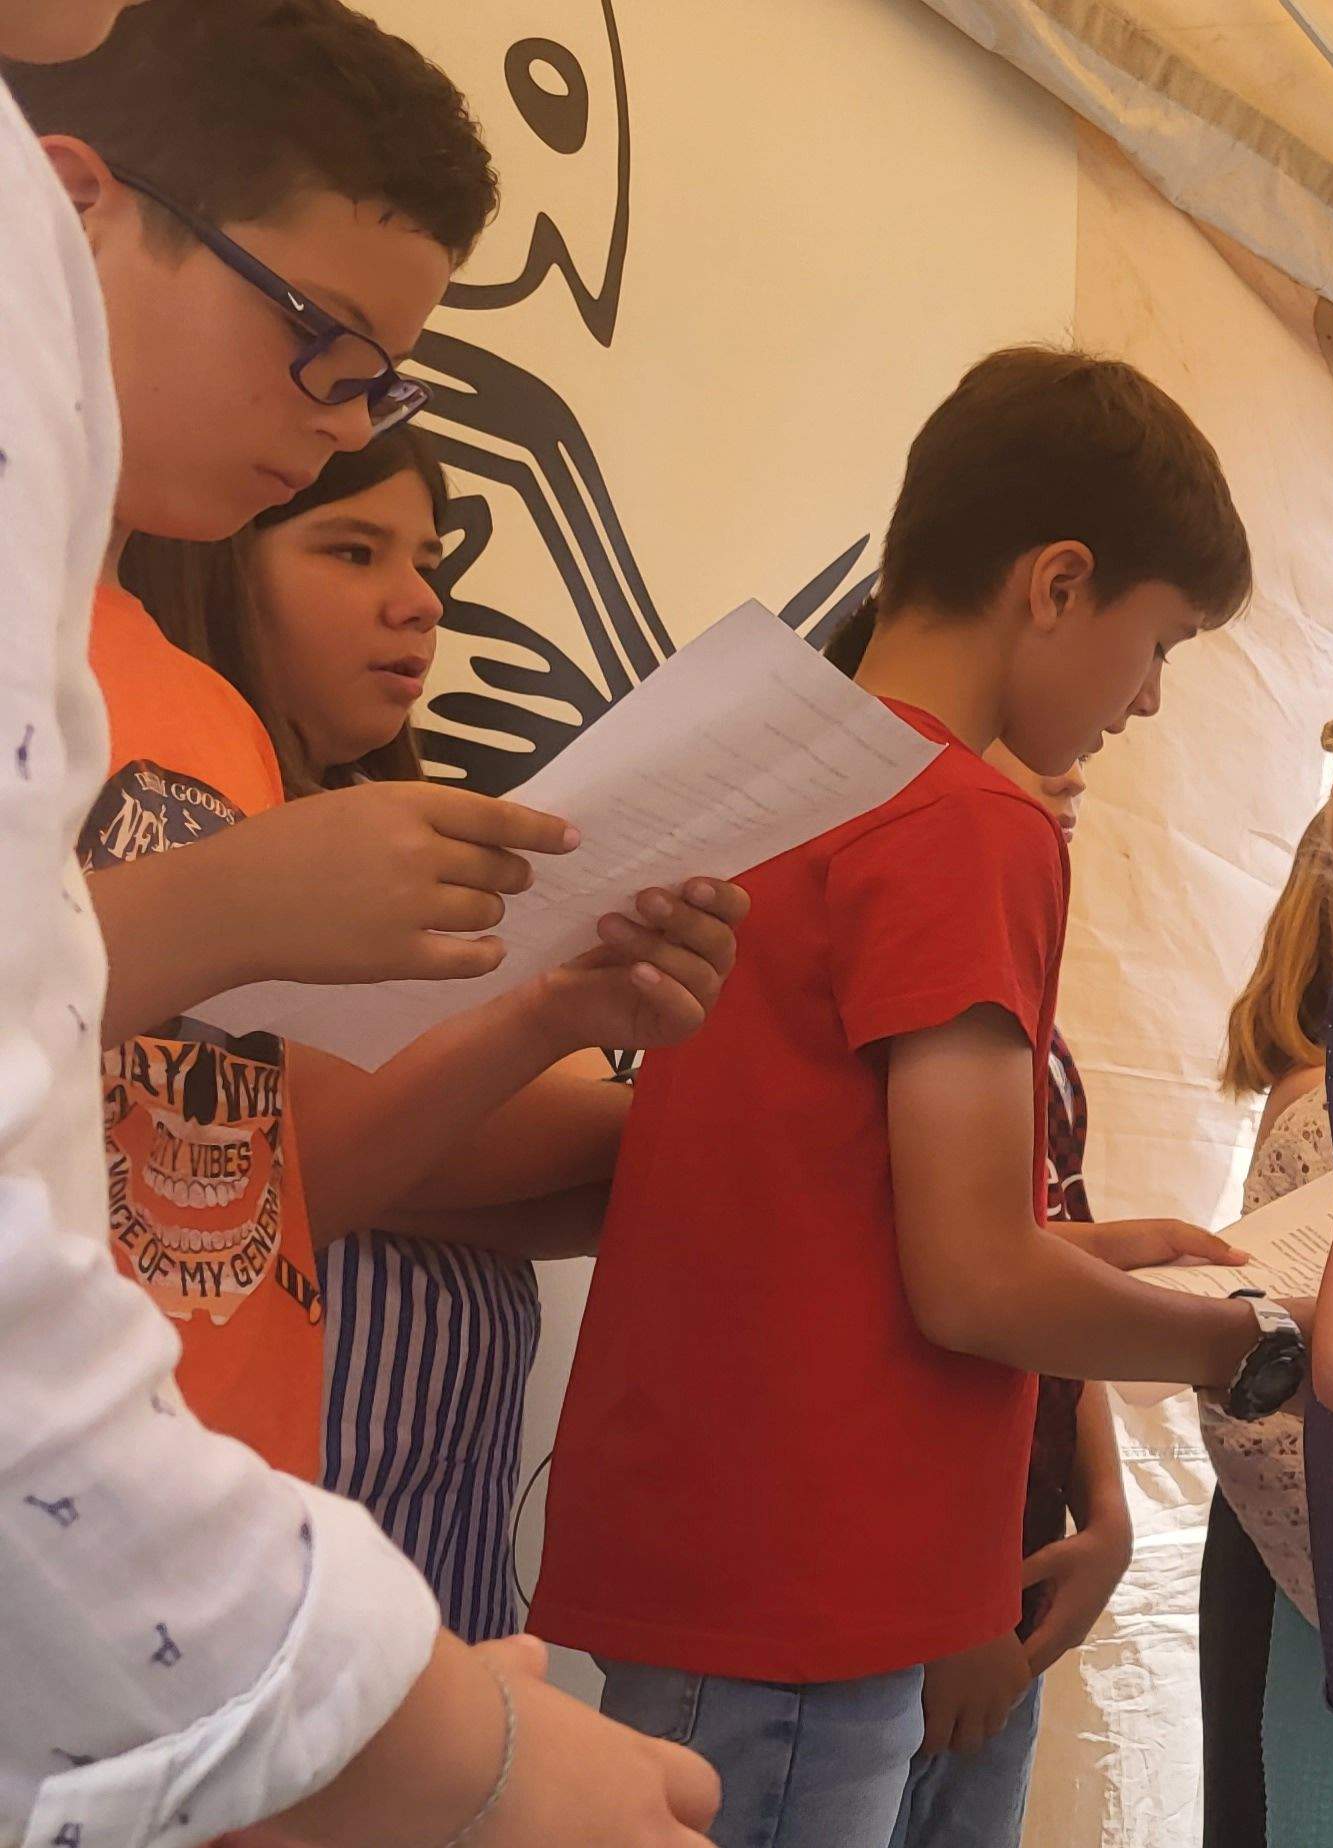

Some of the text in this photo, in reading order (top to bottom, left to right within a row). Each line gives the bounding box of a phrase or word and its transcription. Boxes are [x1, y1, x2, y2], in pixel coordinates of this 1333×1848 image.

[171, 783, 235, 825] GOODS
[189, 1141, 251, 1178] VIBES
[109, 1155, 147, 1249] VOICE
[138, 1237, 176, 1283] OF
[179, 1261, 225, 1297] MY
